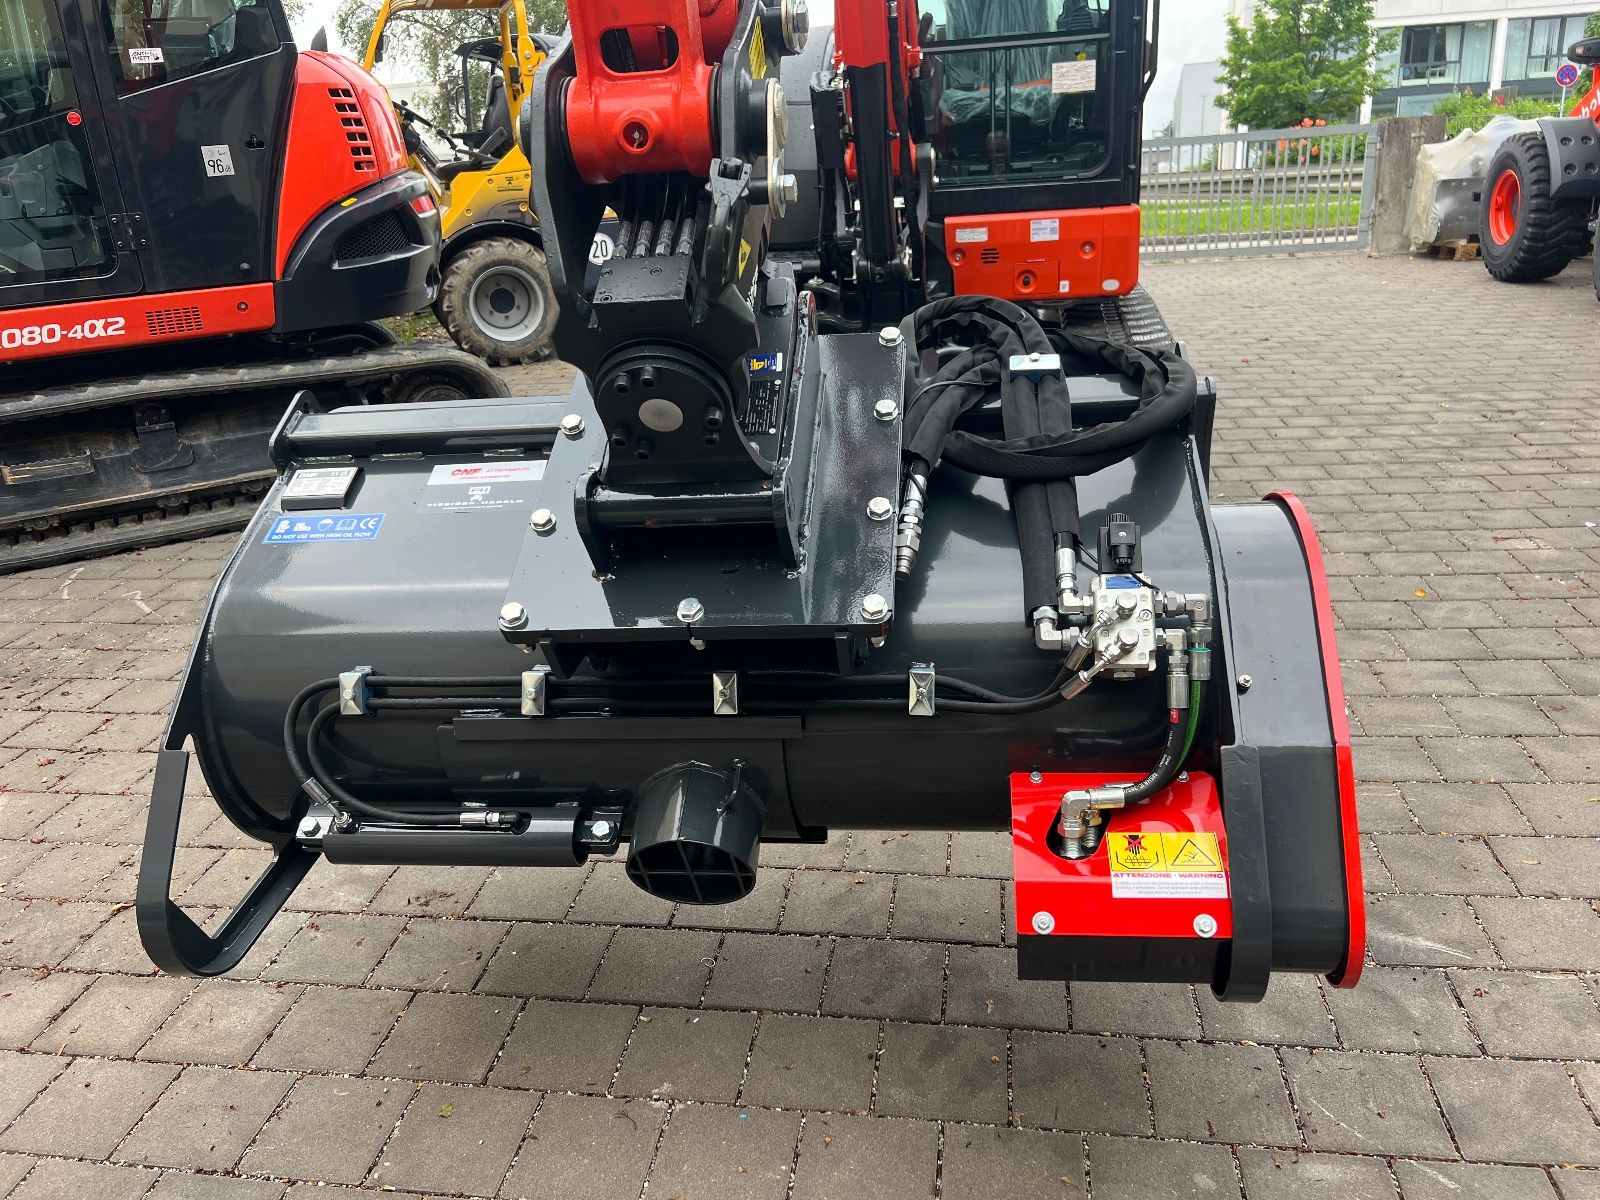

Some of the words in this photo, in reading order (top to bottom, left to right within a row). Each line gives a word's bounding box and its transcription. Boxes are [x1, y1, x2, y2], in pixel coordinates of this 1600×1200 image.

[208, 159, 224, 173] 96
[593, 240, 608, 258] 20
[450, 468, 482, 477] CNF
